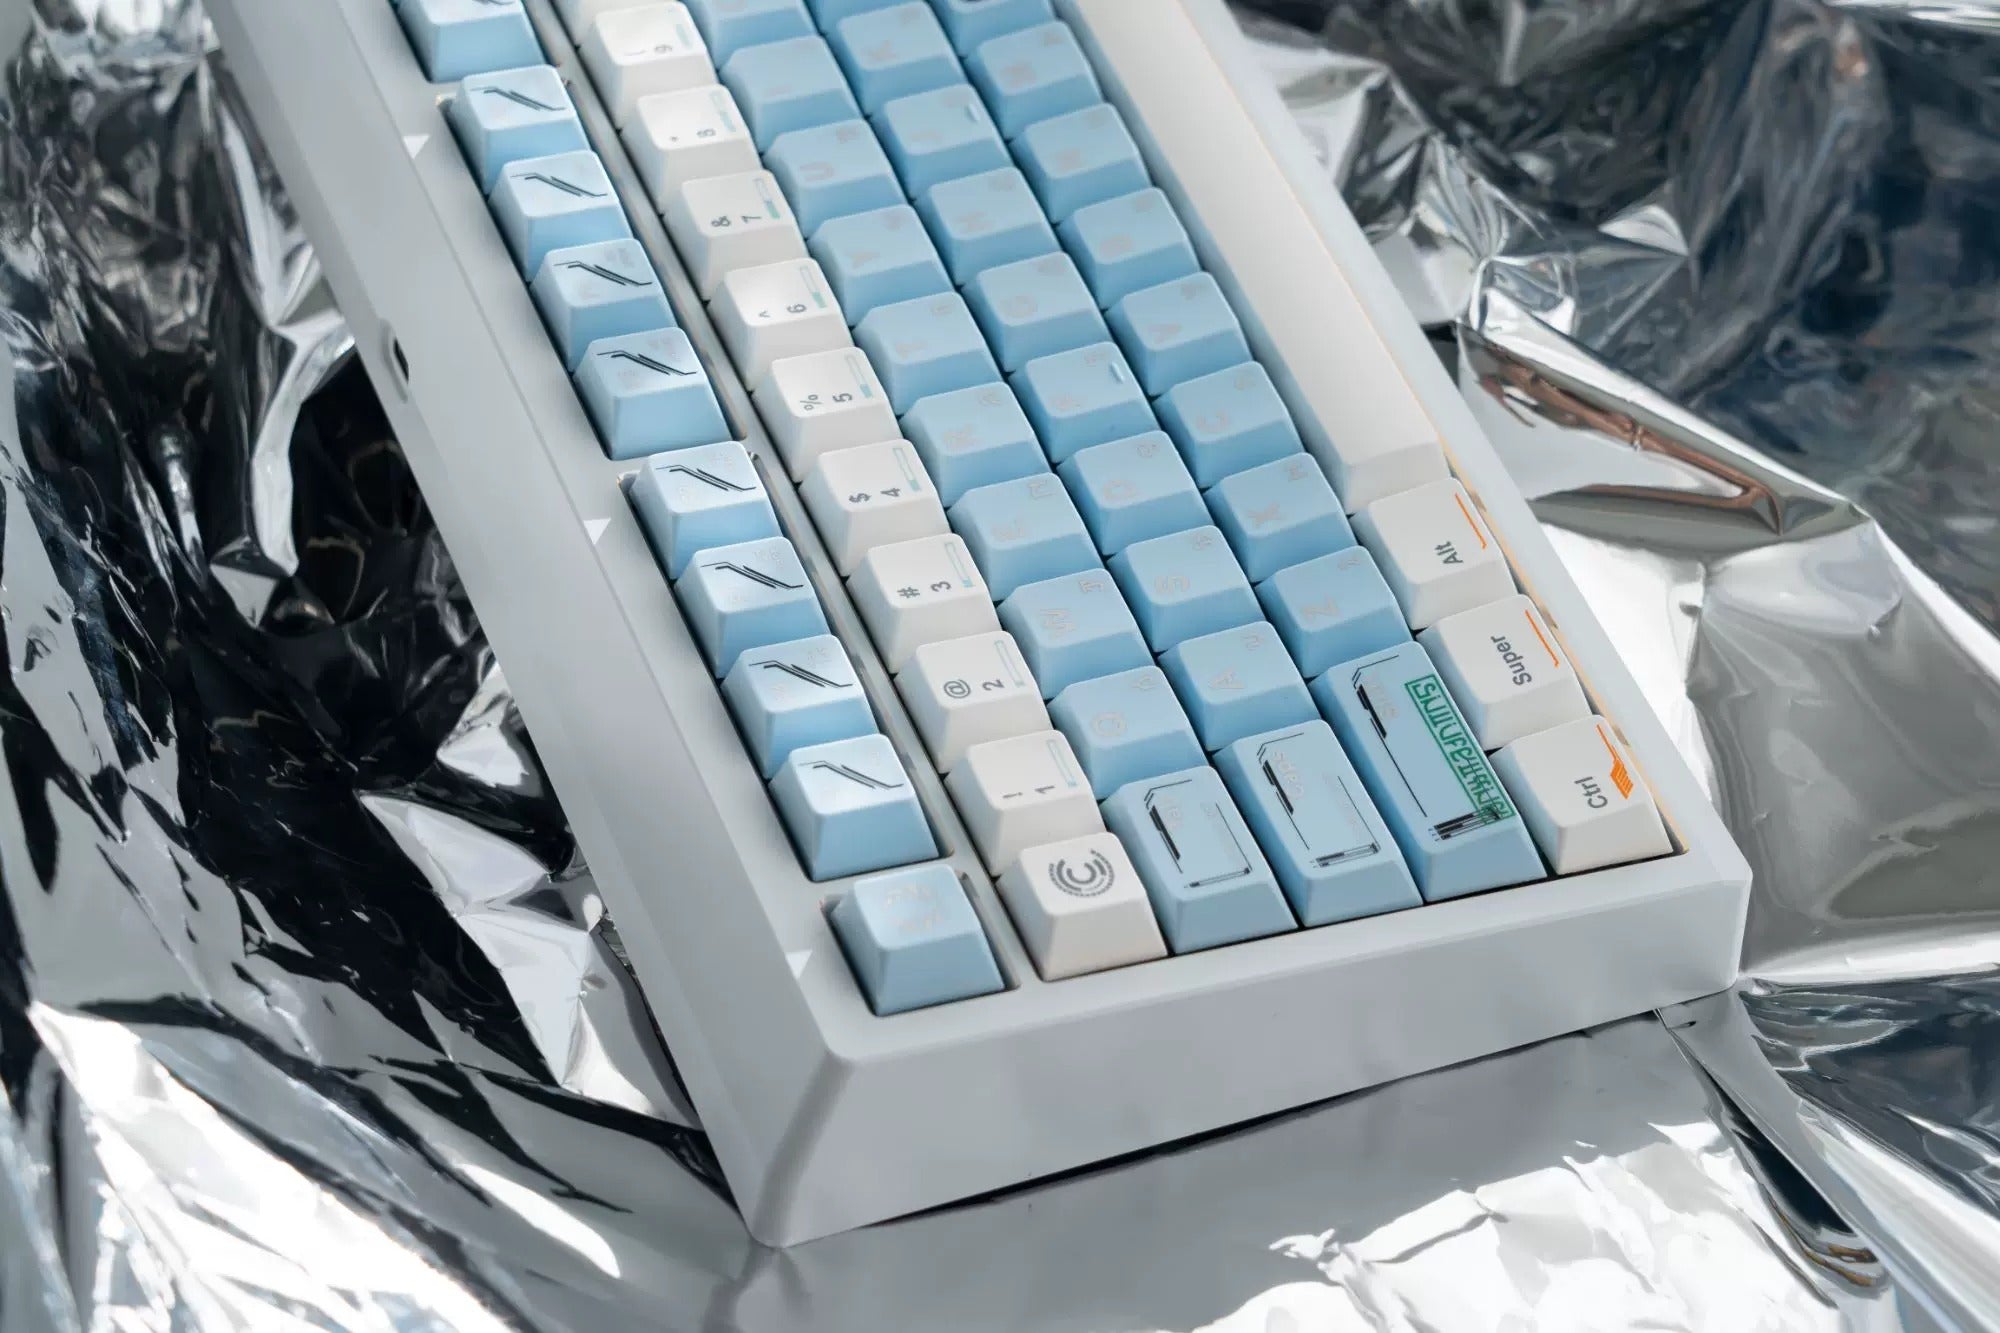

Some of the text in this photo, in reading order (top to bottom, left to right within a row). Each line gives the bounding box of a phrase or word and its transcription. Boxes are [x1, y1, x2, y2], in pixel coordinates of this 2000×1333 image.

[711, 216, 731, 228] &
[740, 214, 762, 224] 7
[786, 303, 807, 315] 6
[800, 393, 822, 412] %
[831, 392, 853, 404] 5
[848, 492, 873, 504] $
[879, 486, 901, 498] 4
[1434, 540, 1464, 565] Alt
[896, 585, 921, 599] #
[930, 580, 952, 593] 3
[1039, 608, 1078, 638] W
[1489, 635, 1533, 686] Super
[981, 678, 1005, 692] 2
[1208, 668, 1245, 691] A
[942, 678, 972, 700] @
[1002, 791, 1024, 799] !
[1033, 784, 1057, 795] 1
[1574, 775, 1609, 809] Ctrl
